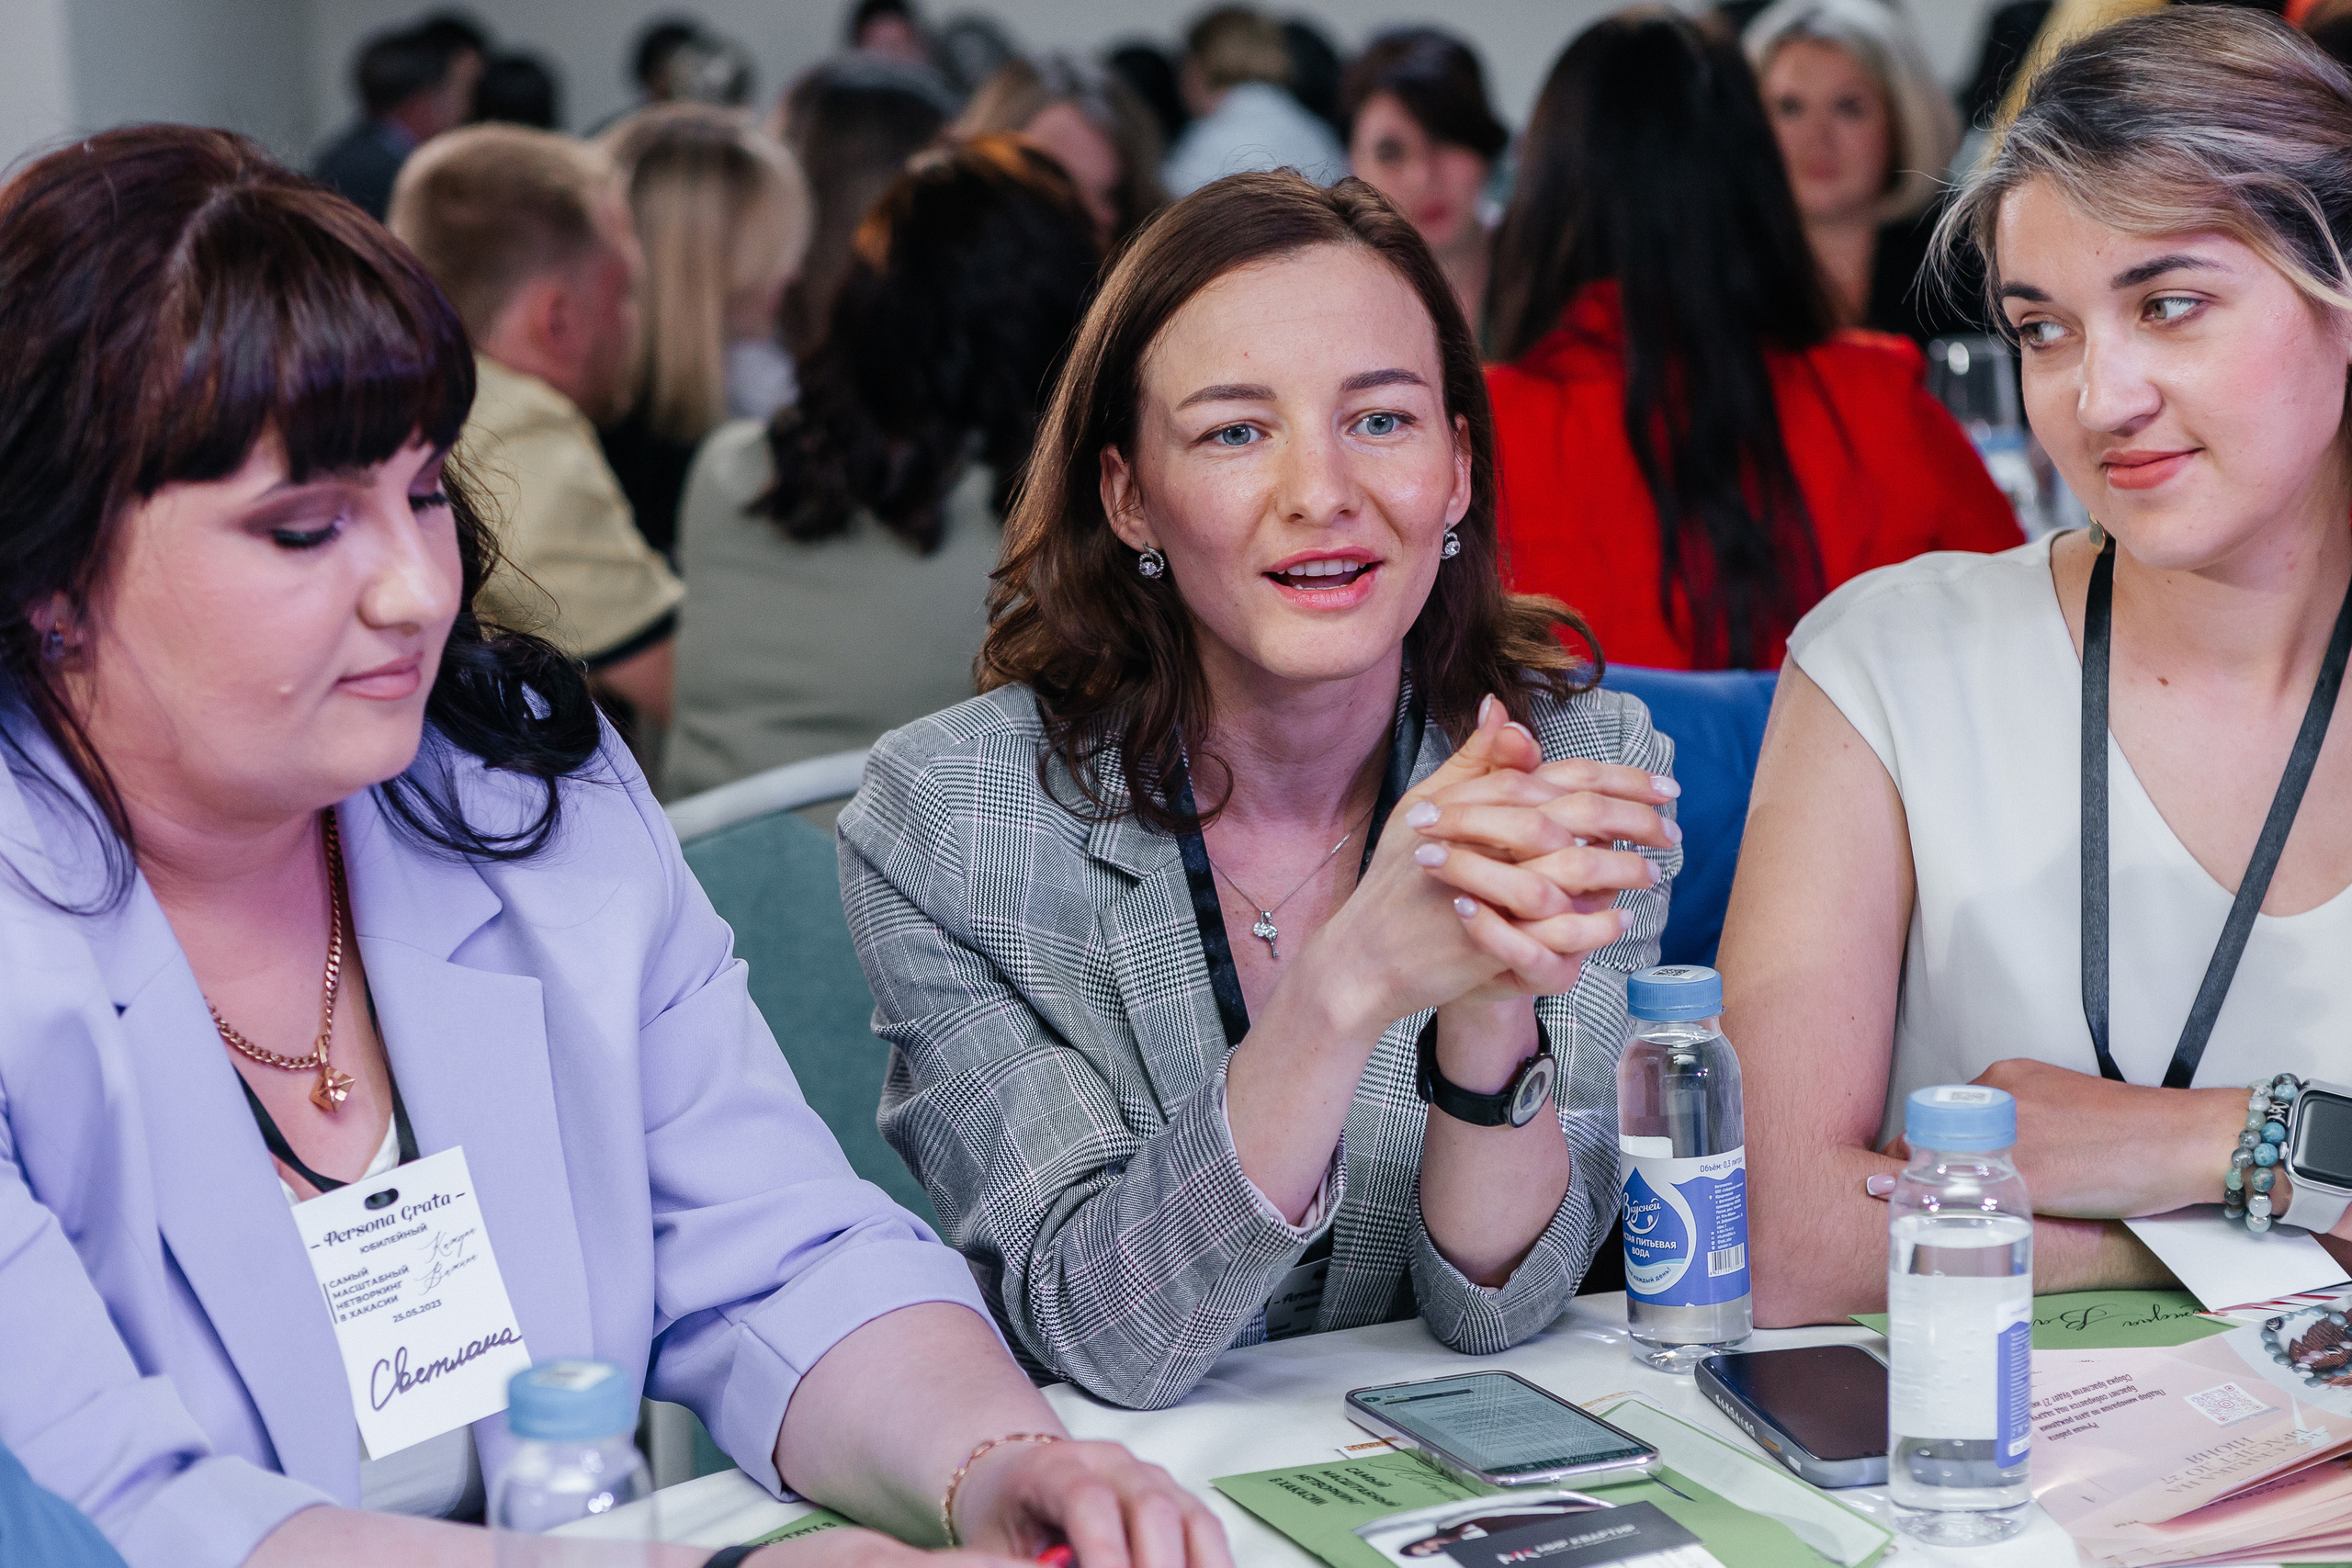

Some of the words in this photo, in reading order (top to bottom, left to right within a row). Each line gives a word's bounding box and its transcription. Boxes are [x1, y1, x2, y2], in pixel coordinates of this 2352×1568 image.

[1724, 1160, 1732, 1169] 0,3
[323, 1213, 397, 1247] Persona
[401, 1193, 452, 1223] Grata
[359, 1223, 428, 1255] ЮБИЛЕЙНЫЙ
[1635, 1237, 1678, 1250] ПИТЬЕВАЯ
[1632, 1247, 1651, 1258] ВОДА
[329, 1267, 369, 1289] САМЫЙ
[333, 1265, 410, 1300] МАСШТАБНЫЙ
[1655, 1267, 1672, 1282] день!
[335, 1280, 403, 1311] НЕТВОРКИНГ
[339, 1314, 348, 1323] В
[349, 1294, 400, 1319] ХАКАСИИ
[392, 1299, 442, 1323] 25.05.2023
[370, 1326, 523, 1412] Светлана
[2106, 1373, 2133, 1386] Сборка
[2071, 1381, 2109, 1396] браслетов
[2108, 1384, 2139, 1398] Браслет
[2138, 1389, 2166, 1401] Подбор
[2042, 1397, 2053, 1407] 27
[2051, 1392, 2074, 1403] будет
[2069, 1393, 2109, 1410] собирается
[2100, 1397, 2139, 1413] минералов
[2053, 1405, 2070, 1415] под
[2074, 1411, 2091, 1421] дате
[2039, 1416, 2075, 1432] рождения
[2072, 1422, 2100, 1434] Ручная
[2047, 1429, 2074, 1441] работа
[2185, 1437, 2255, 1464] ИЮНЯ
[1344, 1467, 1394, 1488] САМЫЙ
[1277, 1480, 1329, 1507] ХАКАСИИ
[1294, 1473, 1366, 1506] НЕТВОРКИНГ
[1318, 1470, 1402, 1508] МАСШТАБНЫЙ
[757, 1525, 825, 1547] ХАКАСИ
